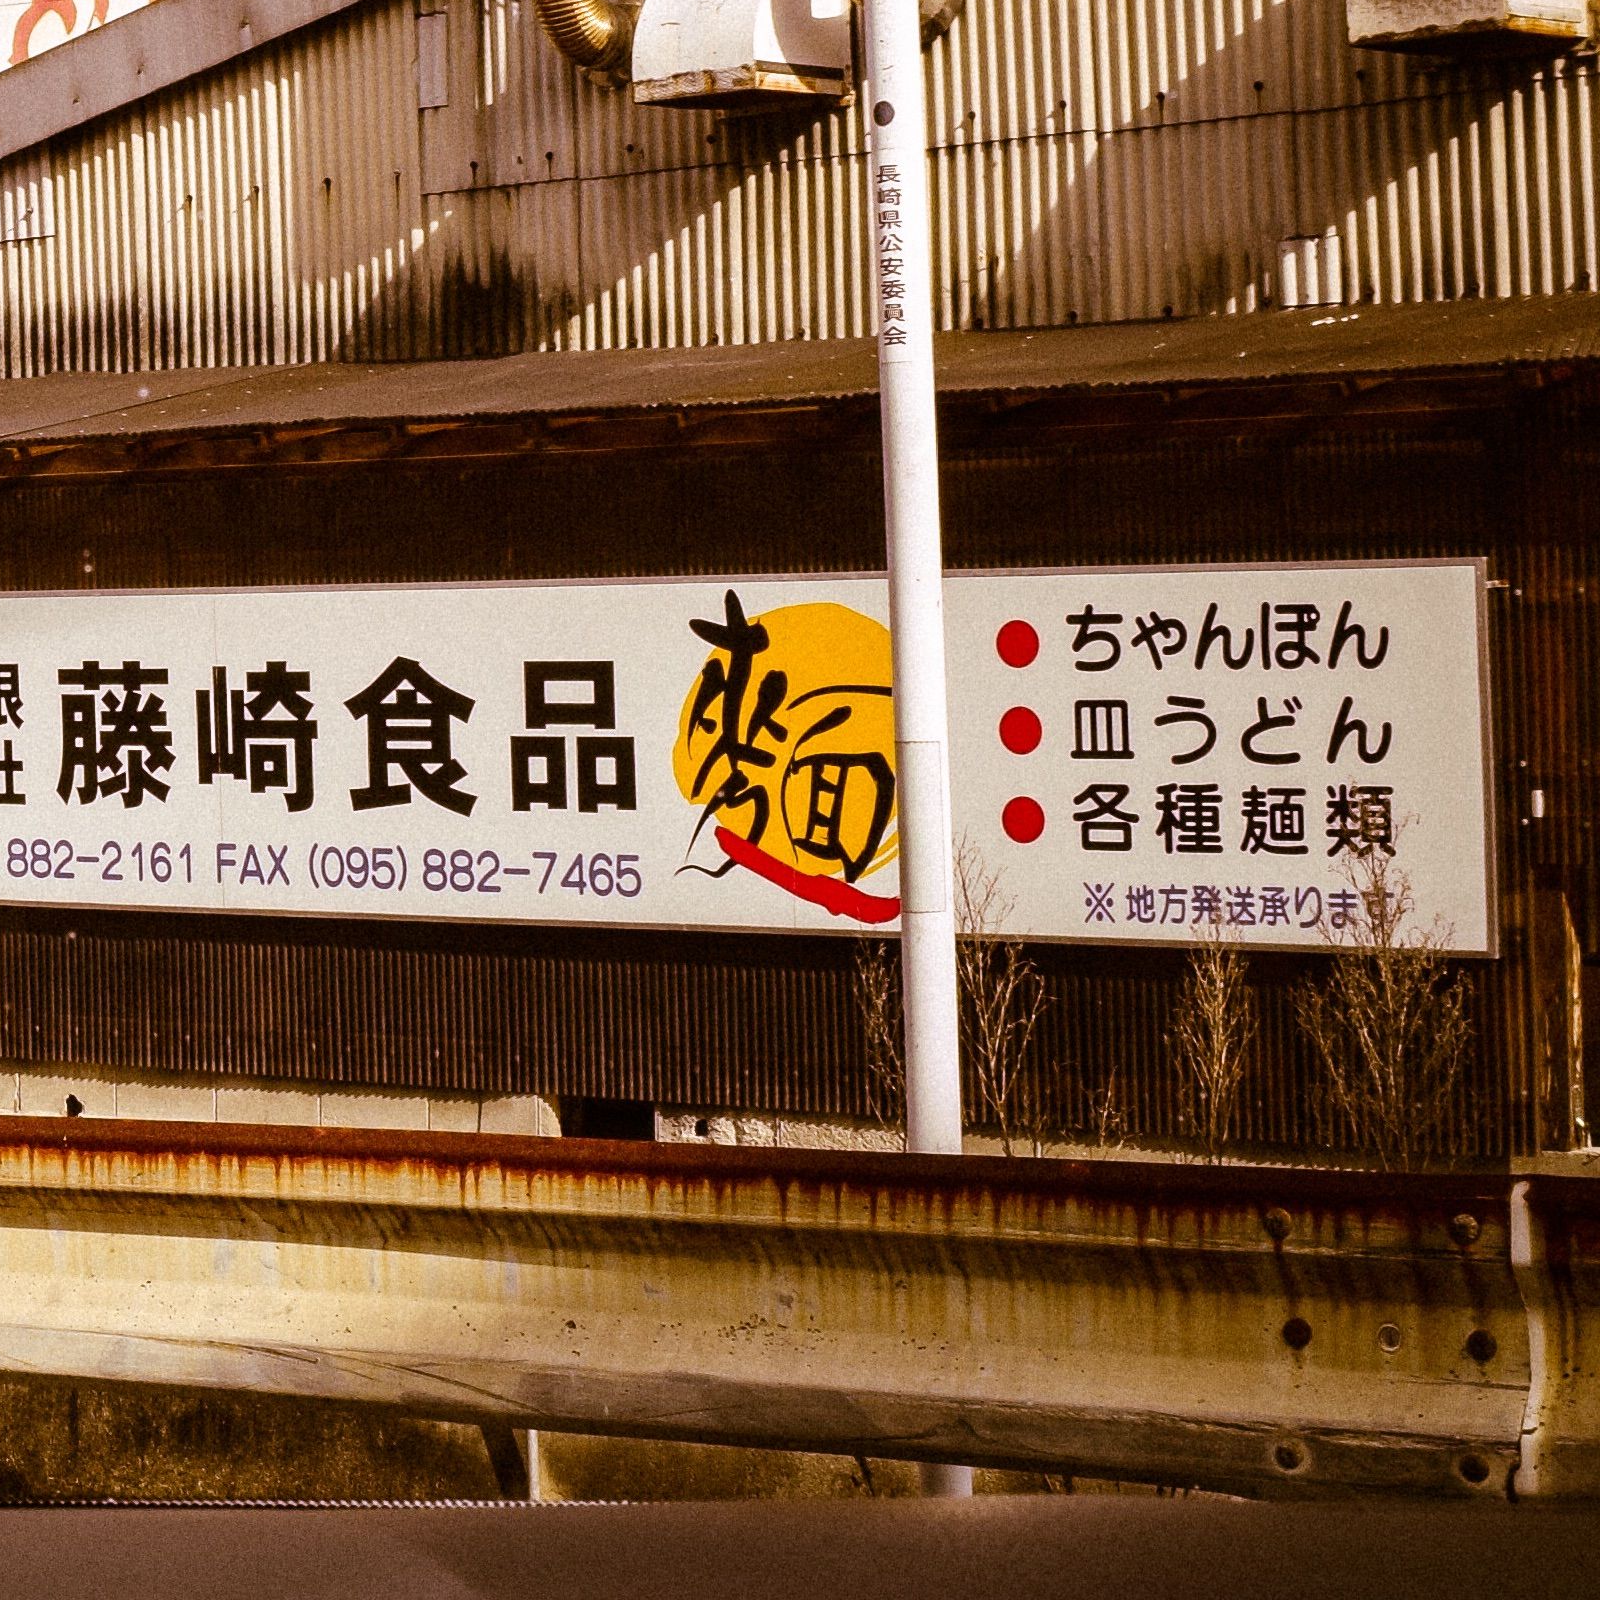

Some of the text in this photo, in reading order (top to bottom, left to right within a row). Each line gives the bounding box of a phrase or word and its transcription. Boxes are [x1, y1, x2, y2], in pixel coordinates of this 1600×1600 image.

[876, 164, 907, 347] 長崎県公安委員会
[1065, 600, 1389, 672] ちゃんぽん
[56, 655, 638, 818] 藤崎食品
[1070, 695, 1392, 765] 皿うどん
[1072, 782, 1397, 858] 各種麺類
[6, 838, 192, 884] 882-2161
[216, 842, 290, 886] FAX
[308, 841, 408, 892] (095)
[422, 847, 642, 898] 882-7465
